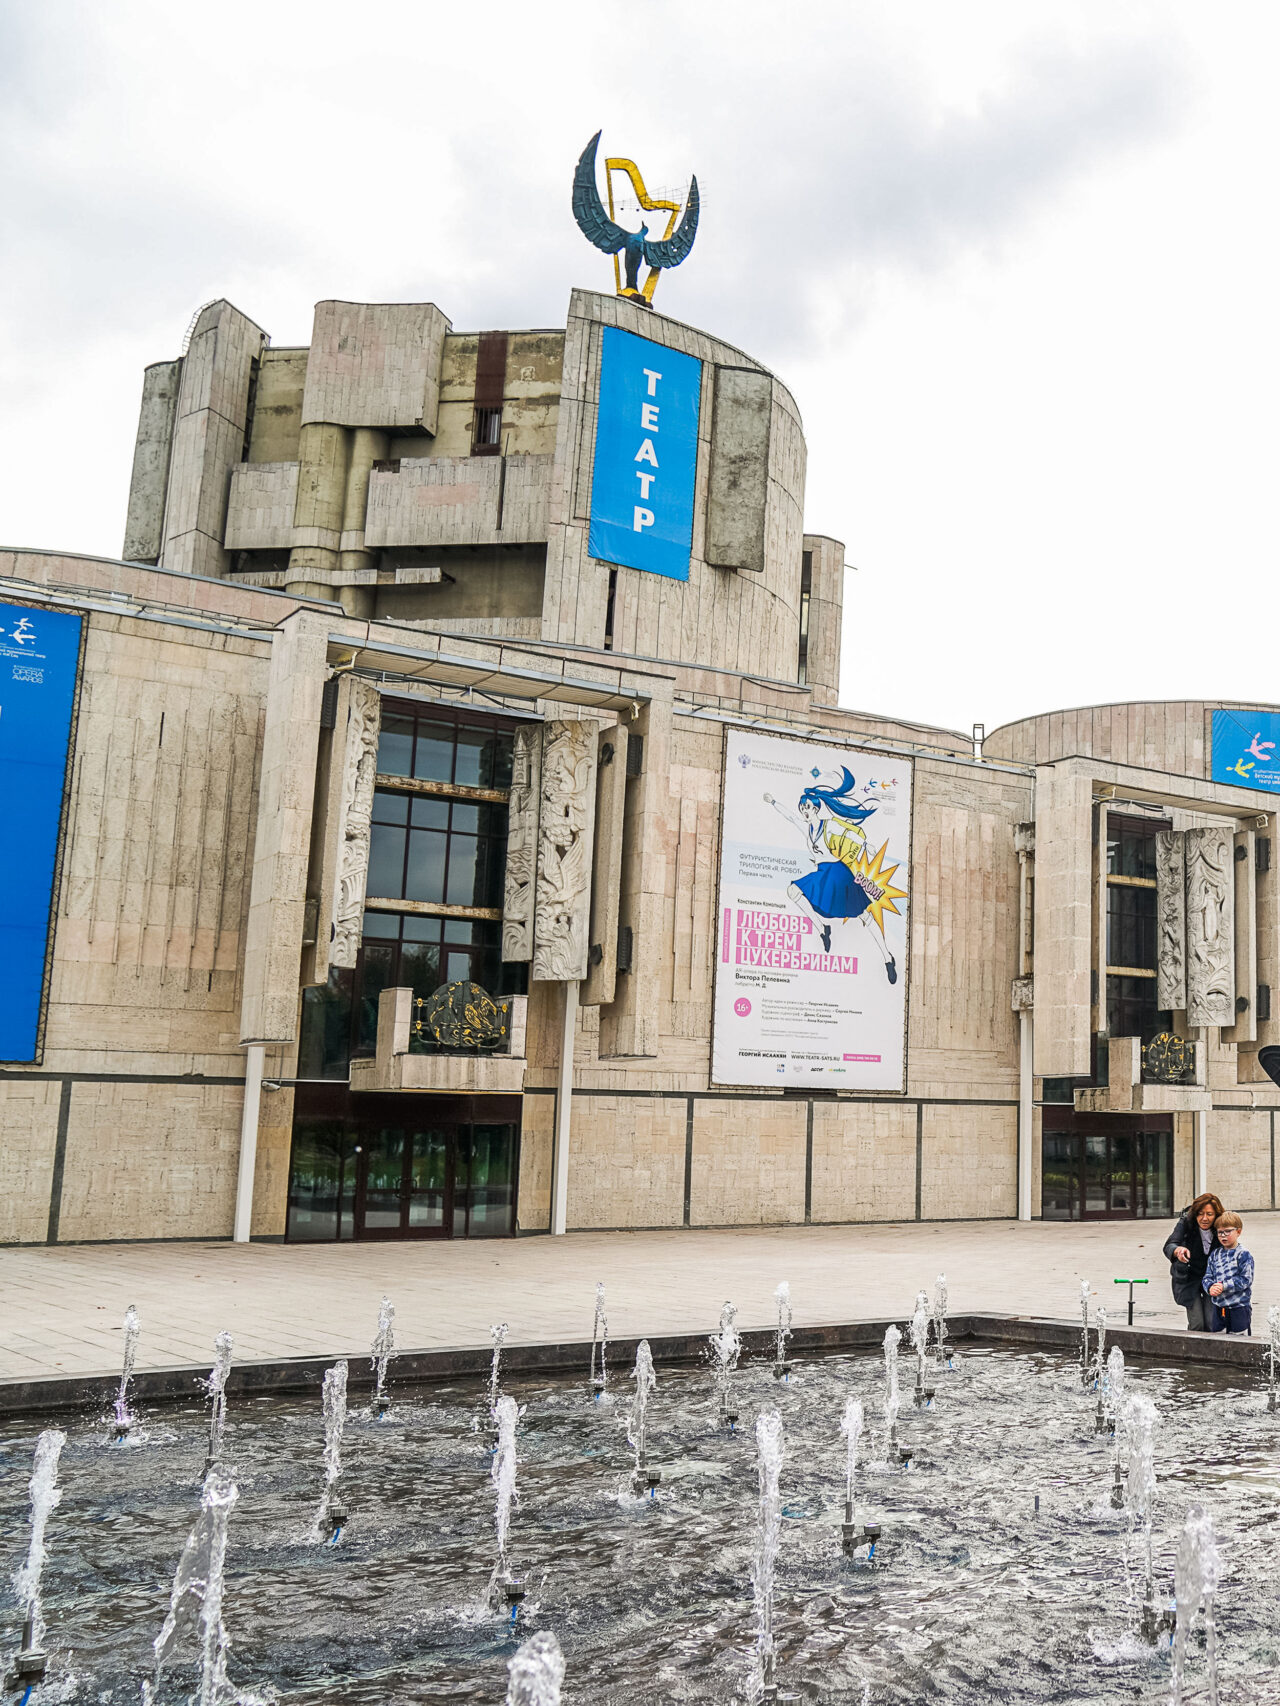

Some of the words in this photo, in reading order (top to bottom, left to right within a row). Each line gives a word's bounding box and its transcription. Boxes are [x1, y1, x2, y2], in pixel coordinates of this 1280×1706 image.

[633, 367, 663, 533] ТЕАТР
[12, 667, 44, 679] OPERA
[739, 853, 797, 866] ФУТУРИСТИЧЕСКАЯ
[739, 861, 771, 870] ТРИЛОГИЯ
[854, 871, 886, 901] BOOM!
[740, 911, 809, 933] ЛЮБОВЬ
[741, 929, 751, 946] К
[756, 931, 797, 951] ТРЕМ
[740, 946, 854, 973] ЦУКЕРБРИНАМ
[735, 972, 760, 982] Виктора
[761, 975, 790, 983] Пелевина
